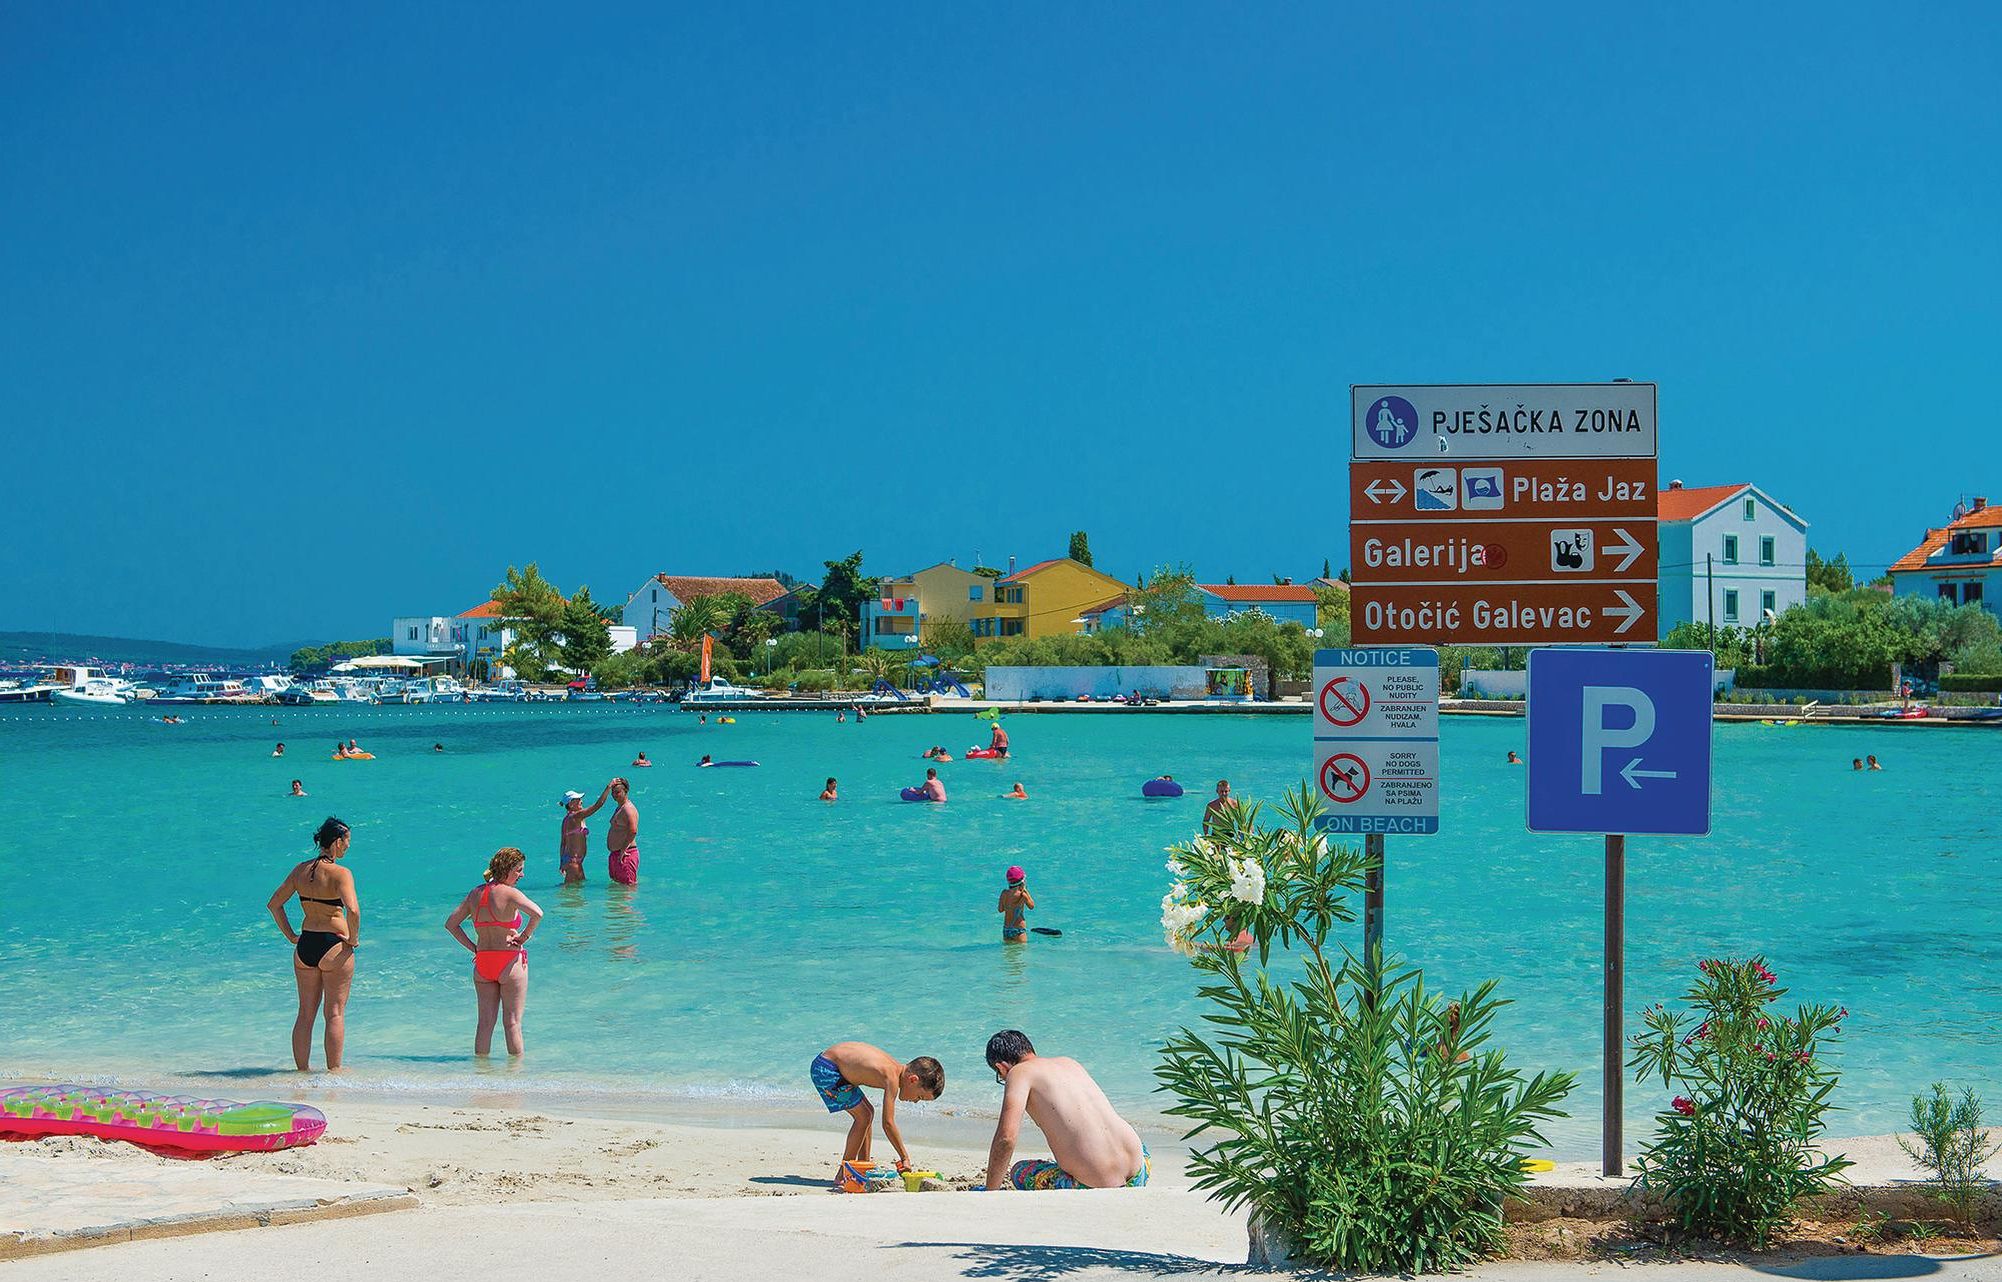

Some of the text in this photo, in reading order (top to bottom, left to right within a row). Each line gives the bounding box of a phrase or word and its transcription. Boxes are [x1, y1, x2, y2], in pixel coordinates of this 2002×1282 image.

[1432, 404, 1641, 434] PJEŠAČKA ZONA
[1513, 476, 1646, 502] Plaža Jaz
[1364, 538, 1487, 573] Galerija
[1365, 600, 1592, 630] Otočić Galevac
[1341, 651, 1411, 665] NOTICE
[1582, 686, 1656, 795] P
[1397, 797, 1423, 805] PLAŽU
[1327, 817, 1426, 832] ON BEACH
